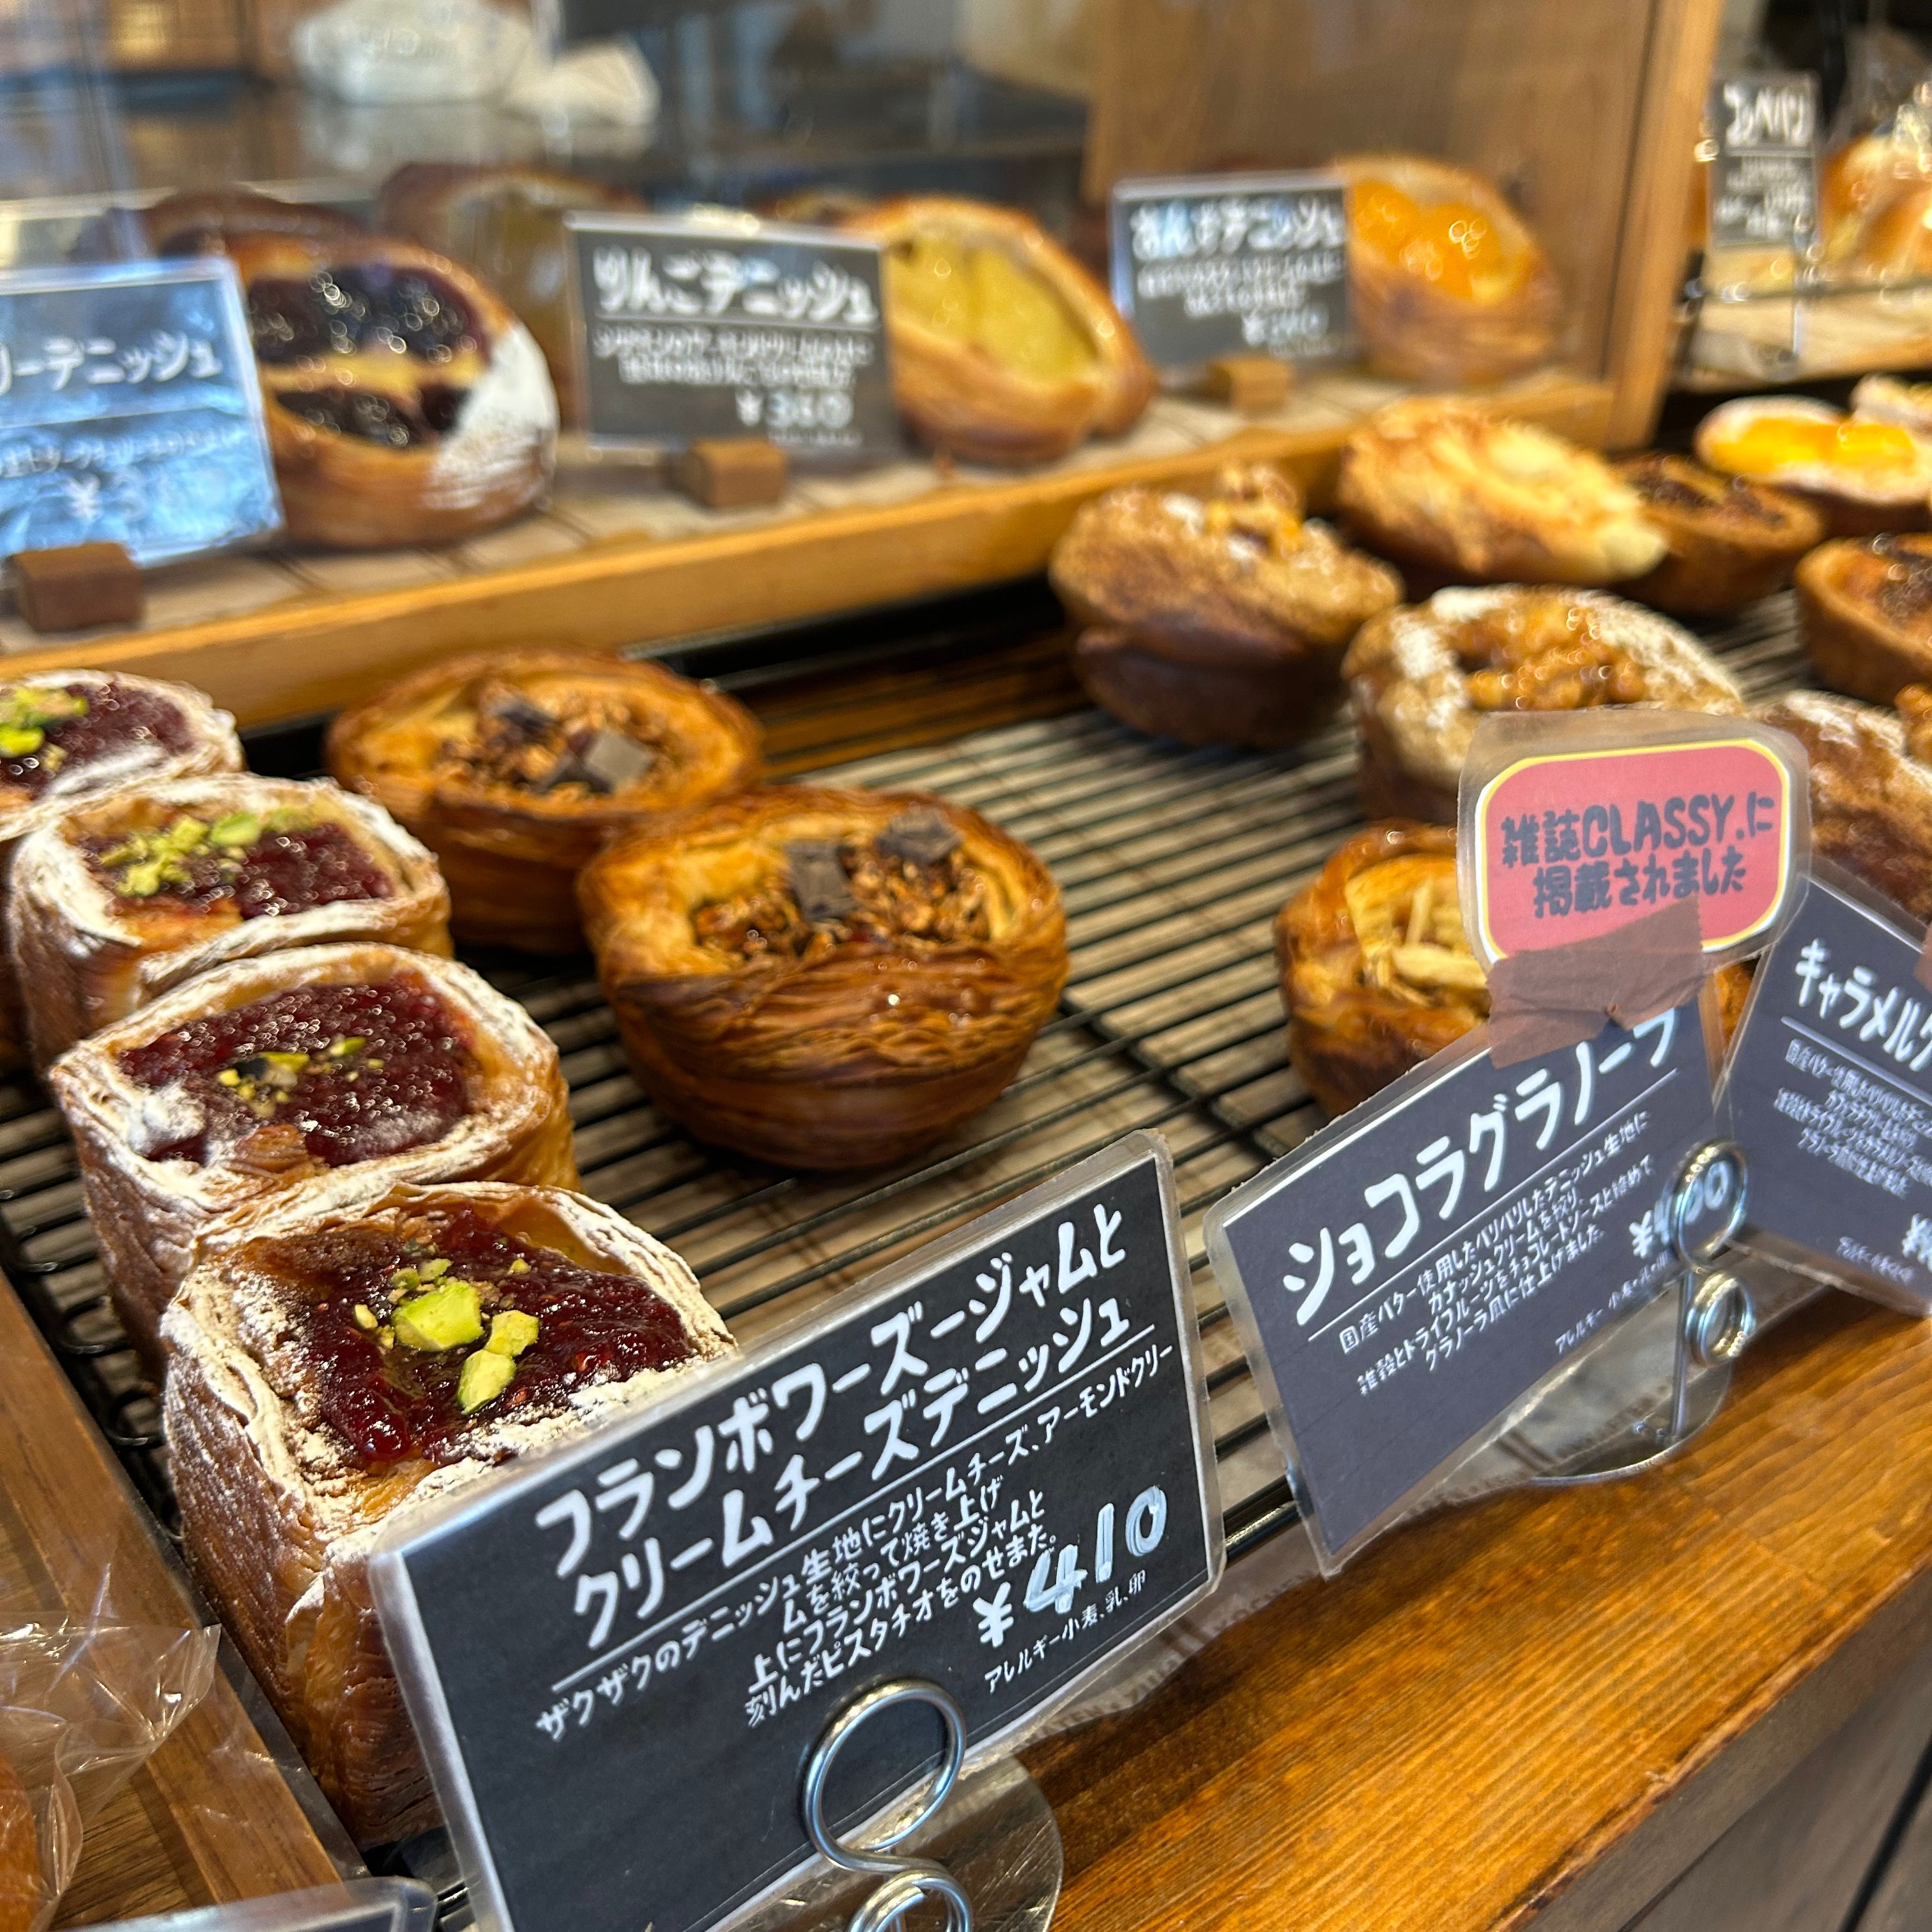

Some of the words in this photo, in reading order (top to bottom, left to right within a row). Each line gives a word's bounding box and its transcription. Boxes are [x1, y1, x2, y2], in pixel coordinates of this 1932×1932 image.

[1501, 791, 1775, 868] 雑誌CLASSY.に
[1533, 845, 1747, 919] 掲載されました
[535, 1202, 1127, 1579] フランボワーズージャムと
[574, 1296, 1130, 1650] クリームチーズデニッシュ
[783, 1475, 1004, 1634] ムを絞って焼き上げ
[748, 1489, 1045, 1694] 上にフランボワーズジャムと
[972, 1485, 1168, 1648] ¥410
